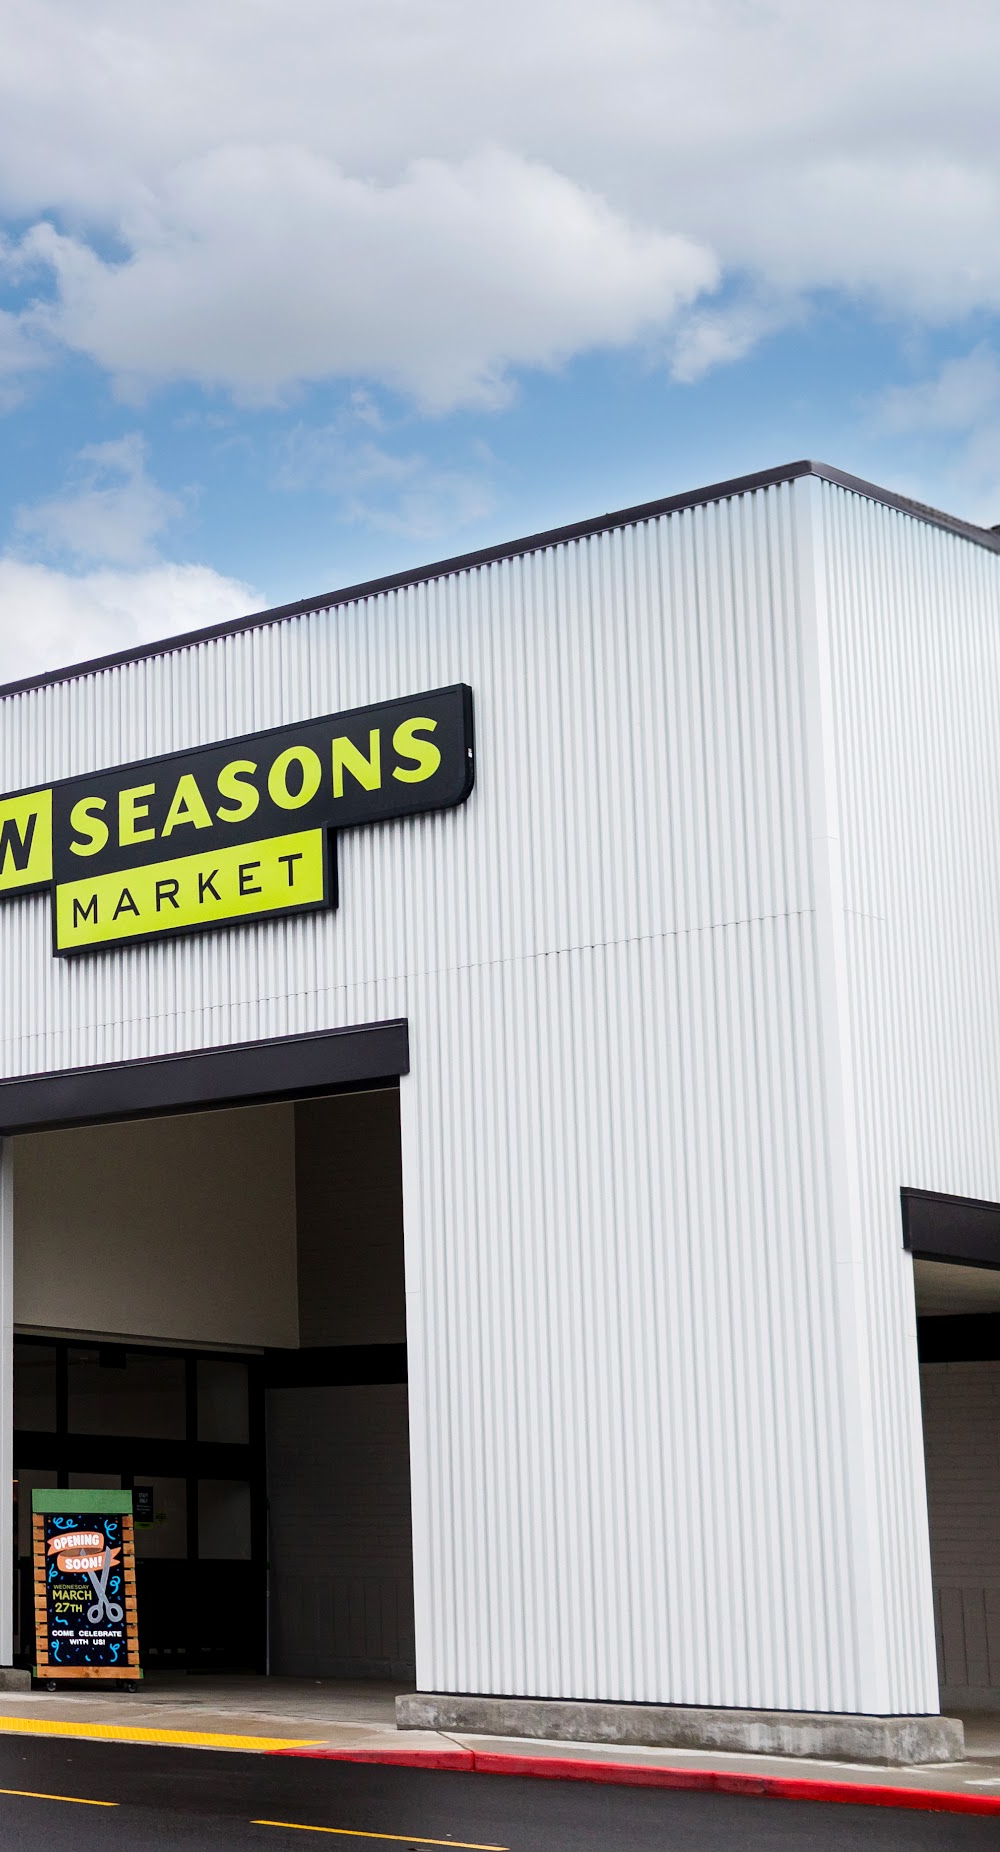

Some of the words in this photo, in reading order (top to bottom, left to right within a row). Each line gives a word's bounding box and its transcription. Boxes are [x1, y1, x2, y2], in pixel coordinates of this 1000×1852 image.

[69, 716, 442, 857] SEASONS
[73, 852, 303, 929] MARKET
[54, 1535, 99, 1550] OPENING
[65, 1556, 102, 1570] SOON!
[52, 1590, 92, 1601] MARCH
[55, 1602, 83, 1613] 27TH
